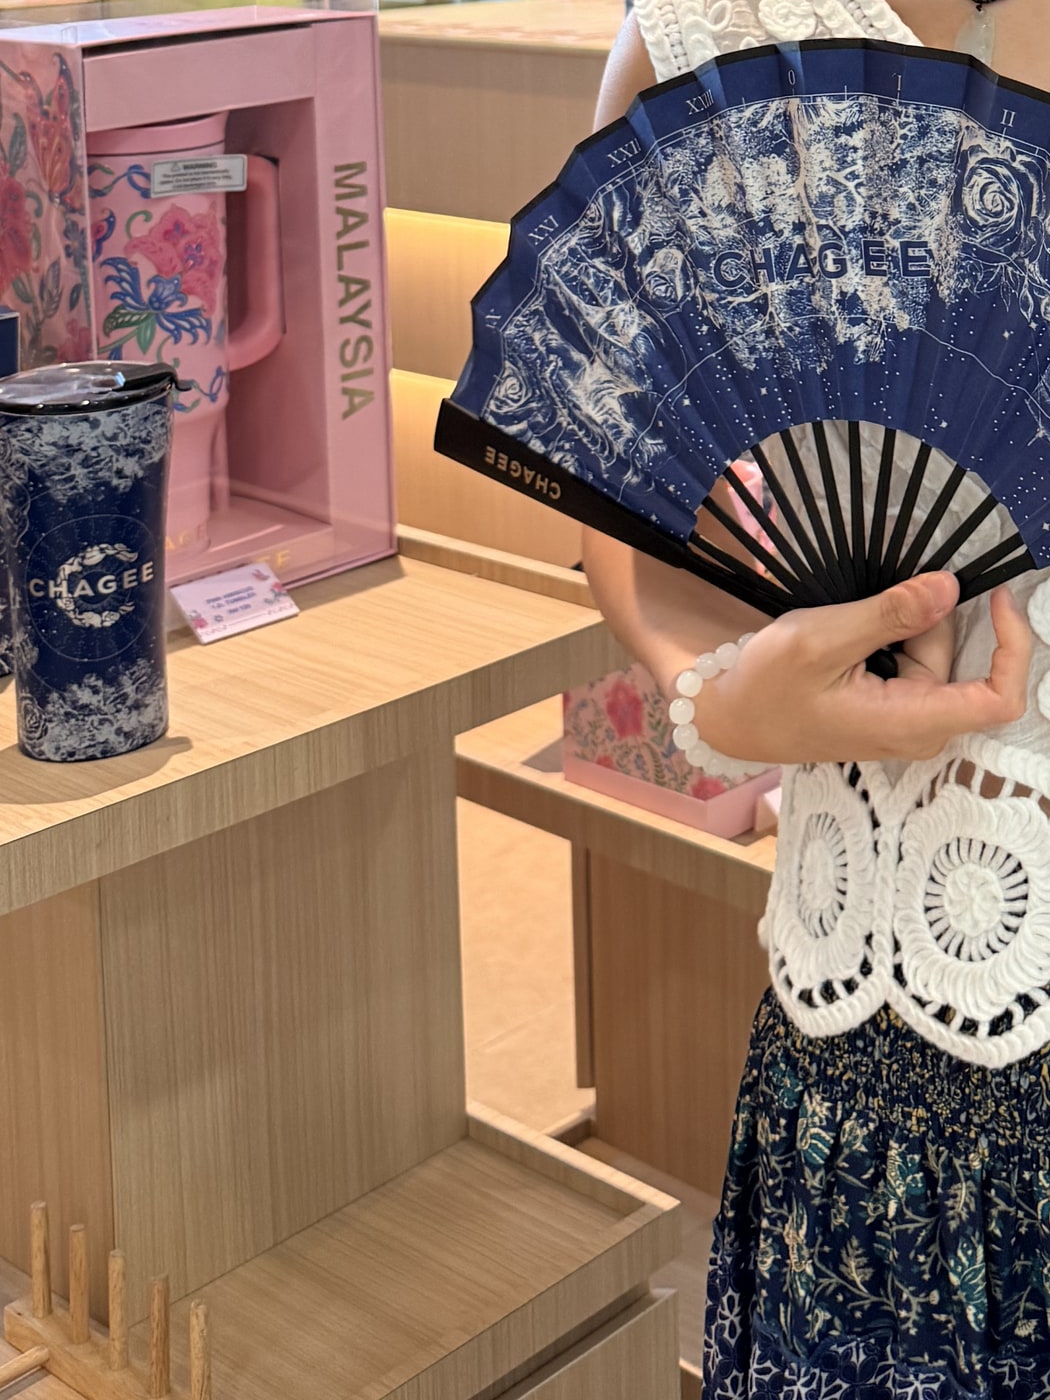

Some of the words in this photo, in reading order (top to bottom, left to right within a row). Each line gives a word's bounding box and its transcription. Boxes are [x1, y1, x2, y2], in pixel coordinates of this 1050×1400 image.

[333, 161, 375, 420] MALAYSIA
[712, 238, 932, 290] CHAGEE
[483, 445, 562, 500] CHAGEE
[29, 561, 154, 598] CHAGEE
